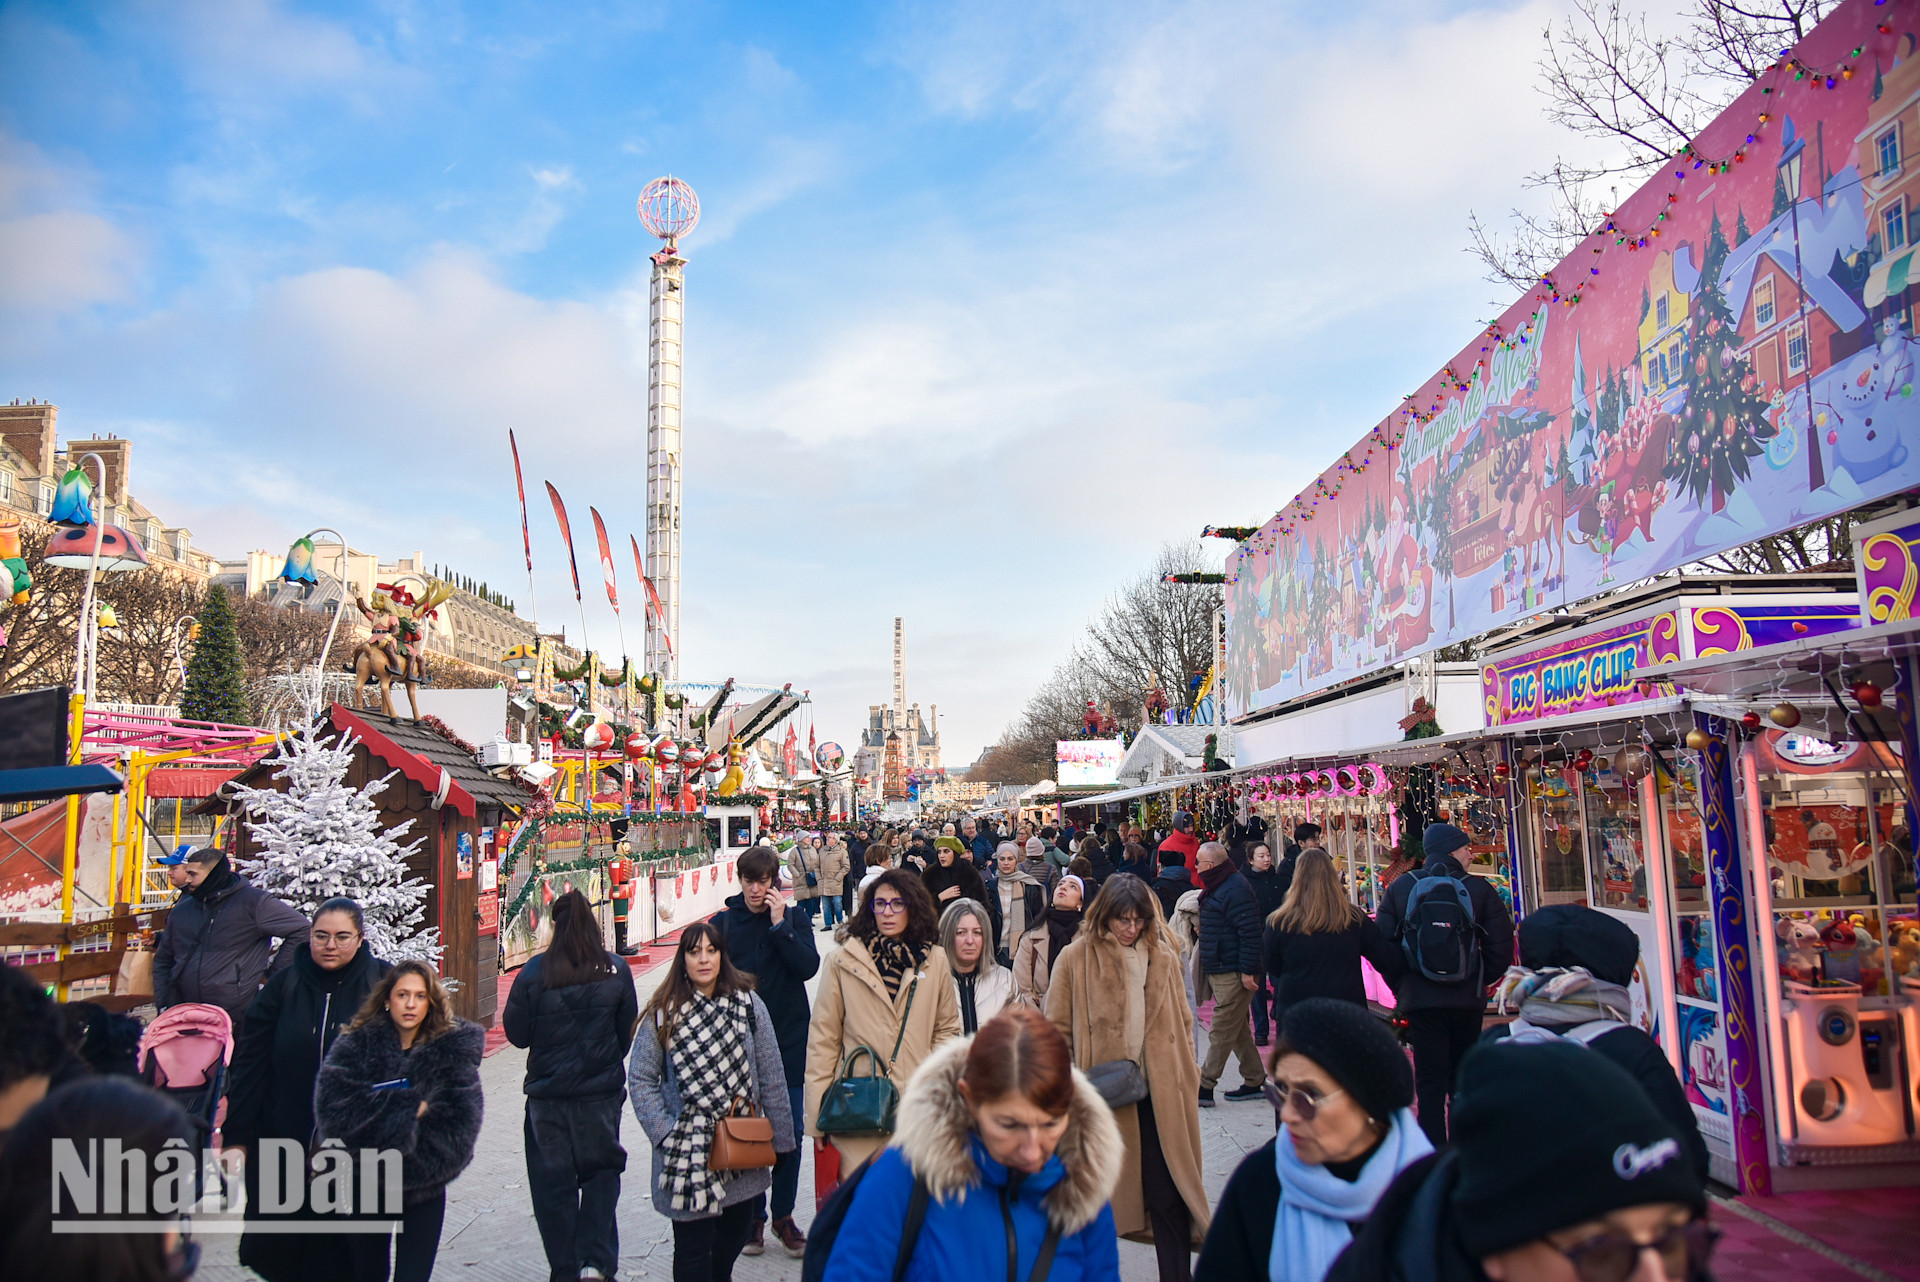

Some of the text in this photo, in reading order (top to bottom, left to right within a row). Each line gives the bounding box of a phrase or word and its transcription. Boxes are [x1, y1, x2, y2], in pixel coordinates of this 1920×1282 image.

[1420, 400, 1460, 460] magie
[1462, 367, 1483, 428] de
[1510, 643, 1637, 714] BIG BANG CLUB
[77, 922, 115, 938] SORTIE
